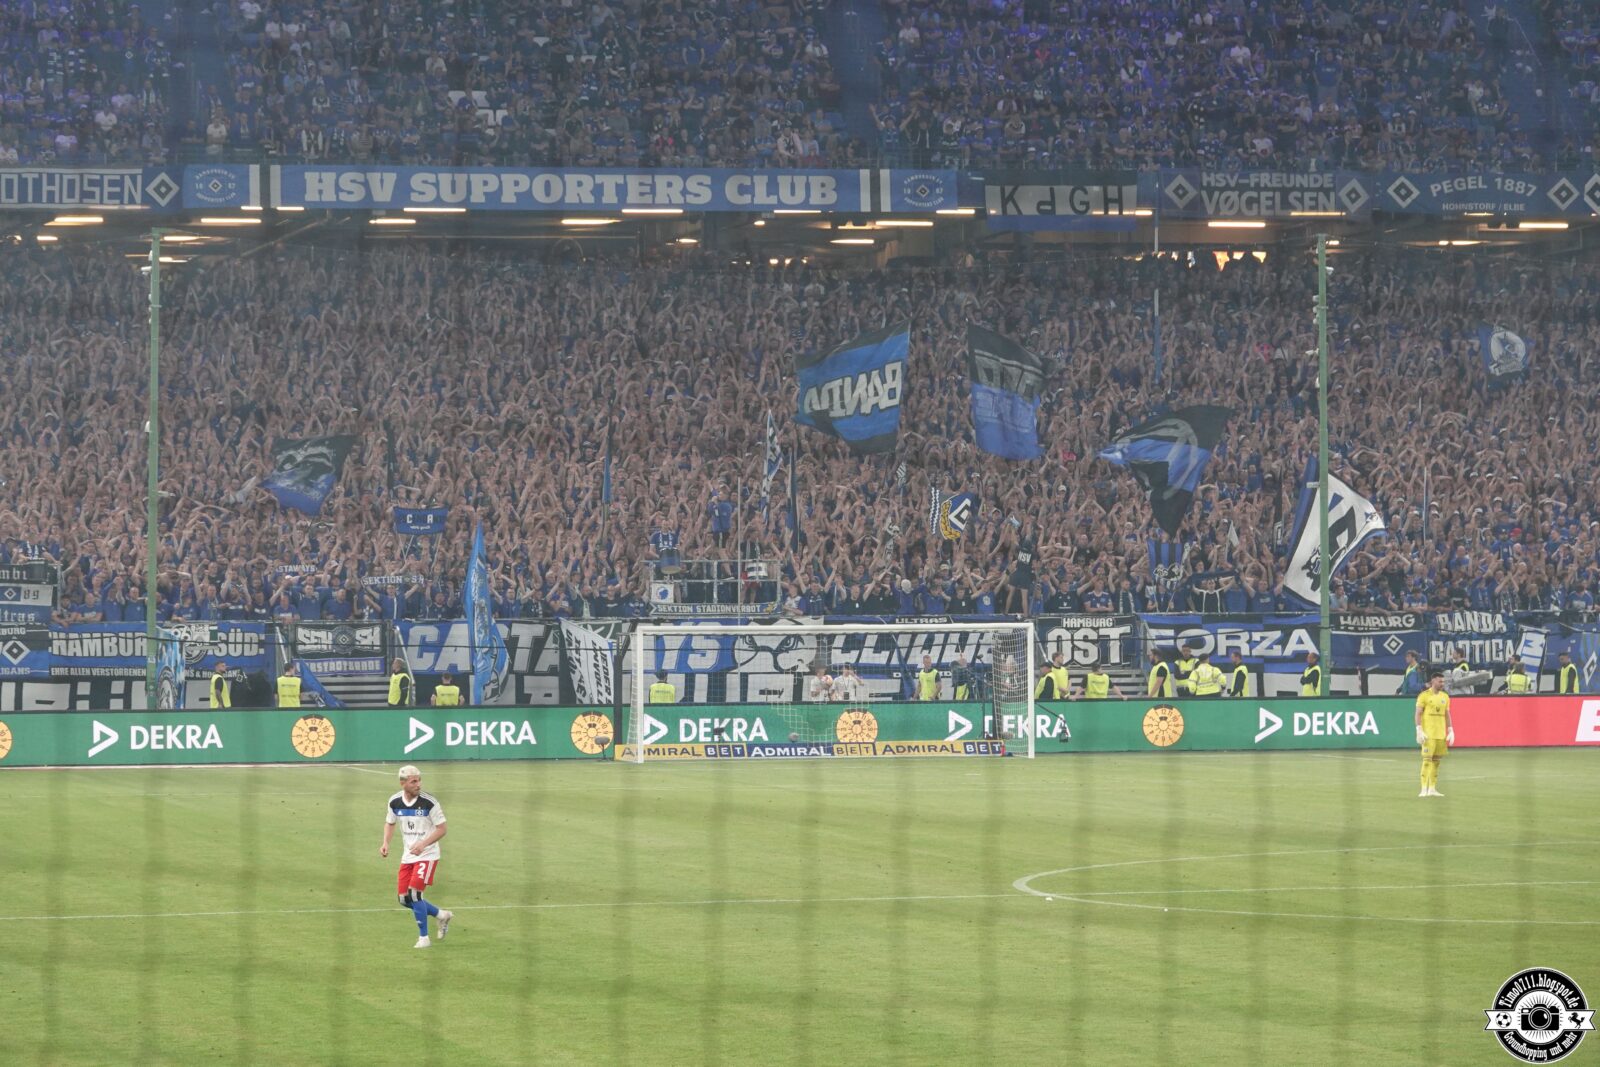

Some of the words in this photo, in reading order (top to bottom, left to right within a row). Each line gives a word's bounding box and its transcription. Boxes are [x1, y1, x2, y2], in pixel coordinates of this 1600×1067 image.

[304, 172, 397, 202] HSV
[410, 172, 712, 205] SUPPORTERS
[725, 174, 838, 205] CLUB
[1201, 172, 1334, 188] HSV-FREUNDE
[1429, 175, 1488, 197] PEGEL
[1493, 177, 1537, 197] 1887
[657, 604, 693, 613] SEKTION
[895, 616, 948, 625] ULTRAS
[1062, 616, 1114, 629] HAMBURG
[0, 627, 26, 636] BURG
[1046, 625, 1131, 666] OST
[1149, 628, 1321, 657] FORZA
[51, 667, 69, 677] EHRE
[70, 667, 91, 677] ALLEN
[445, 720, 538, 746] DEKRA
[678, 717, 769, 743] DEKRA
[983, 714, 1072, 739] DEKRA
[1293, 710, 1380, 737] DEKRA
[129, 723, 223, 751] DEKRA
[706, 746, 743, 757] BET
[750, 746, 832, 757] ADMIRAL
[836, 746, 872, 756] BET
[881, 744, 962, 755] ADMIRAL
[965, 744, 1000, 754] BET
